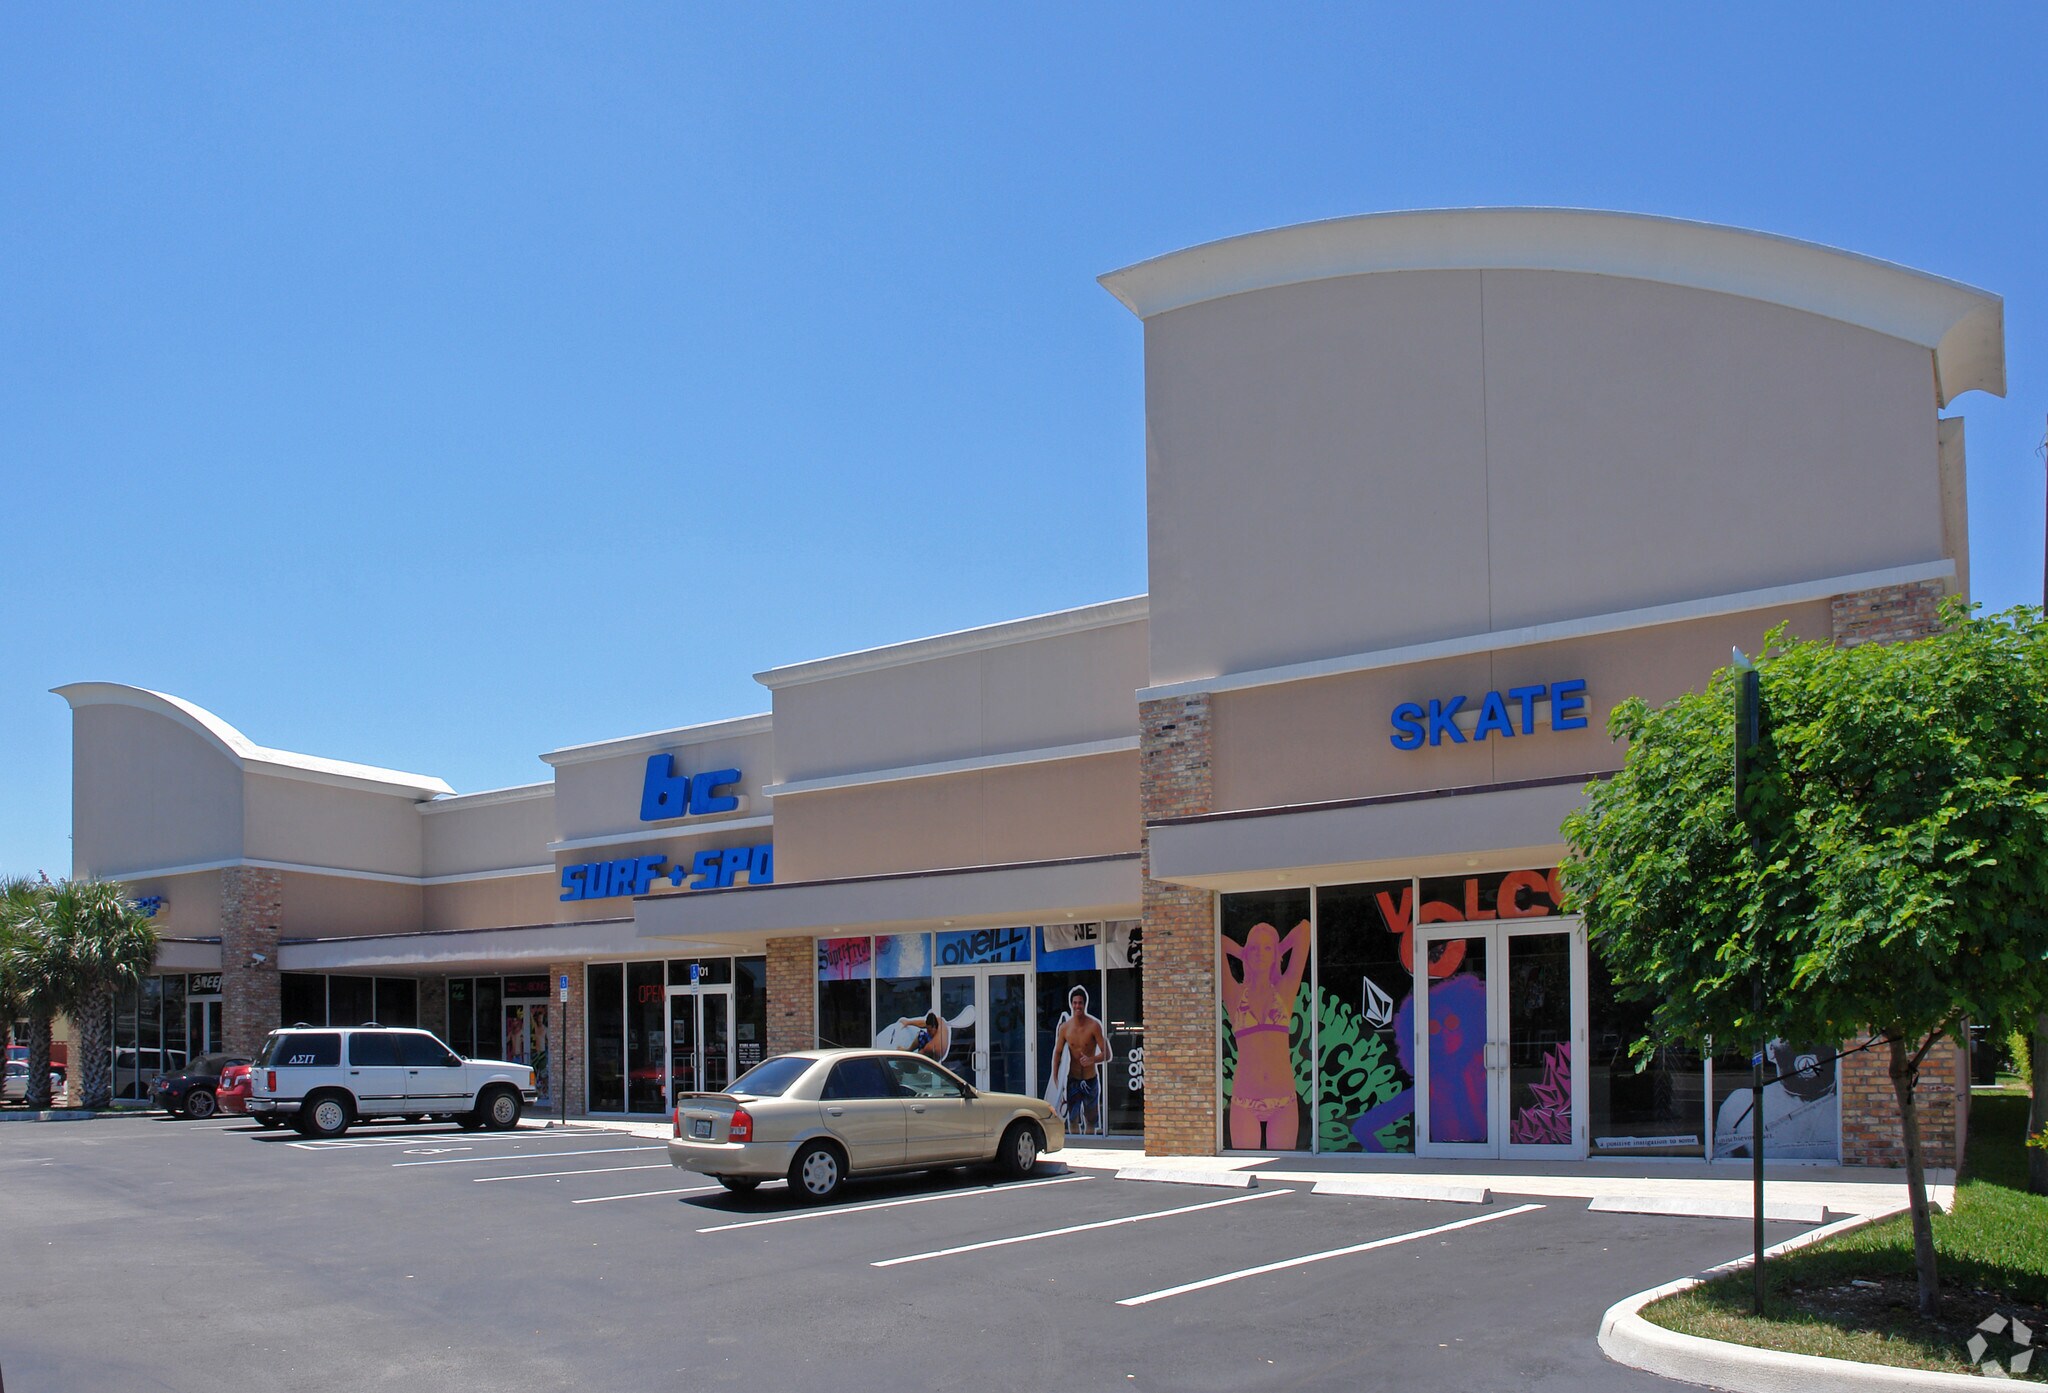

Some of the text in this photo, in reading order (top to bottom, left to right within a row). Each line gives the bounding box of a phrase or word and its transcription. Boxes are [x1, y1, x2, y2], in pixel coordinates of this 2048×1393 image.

[1390, 679, 1588, 750] SKATE
[640, 753, 742, 821] bc
[560, 844, 774, 901] SURF + SPO
[638, 984, 665, 1004] OPEN
